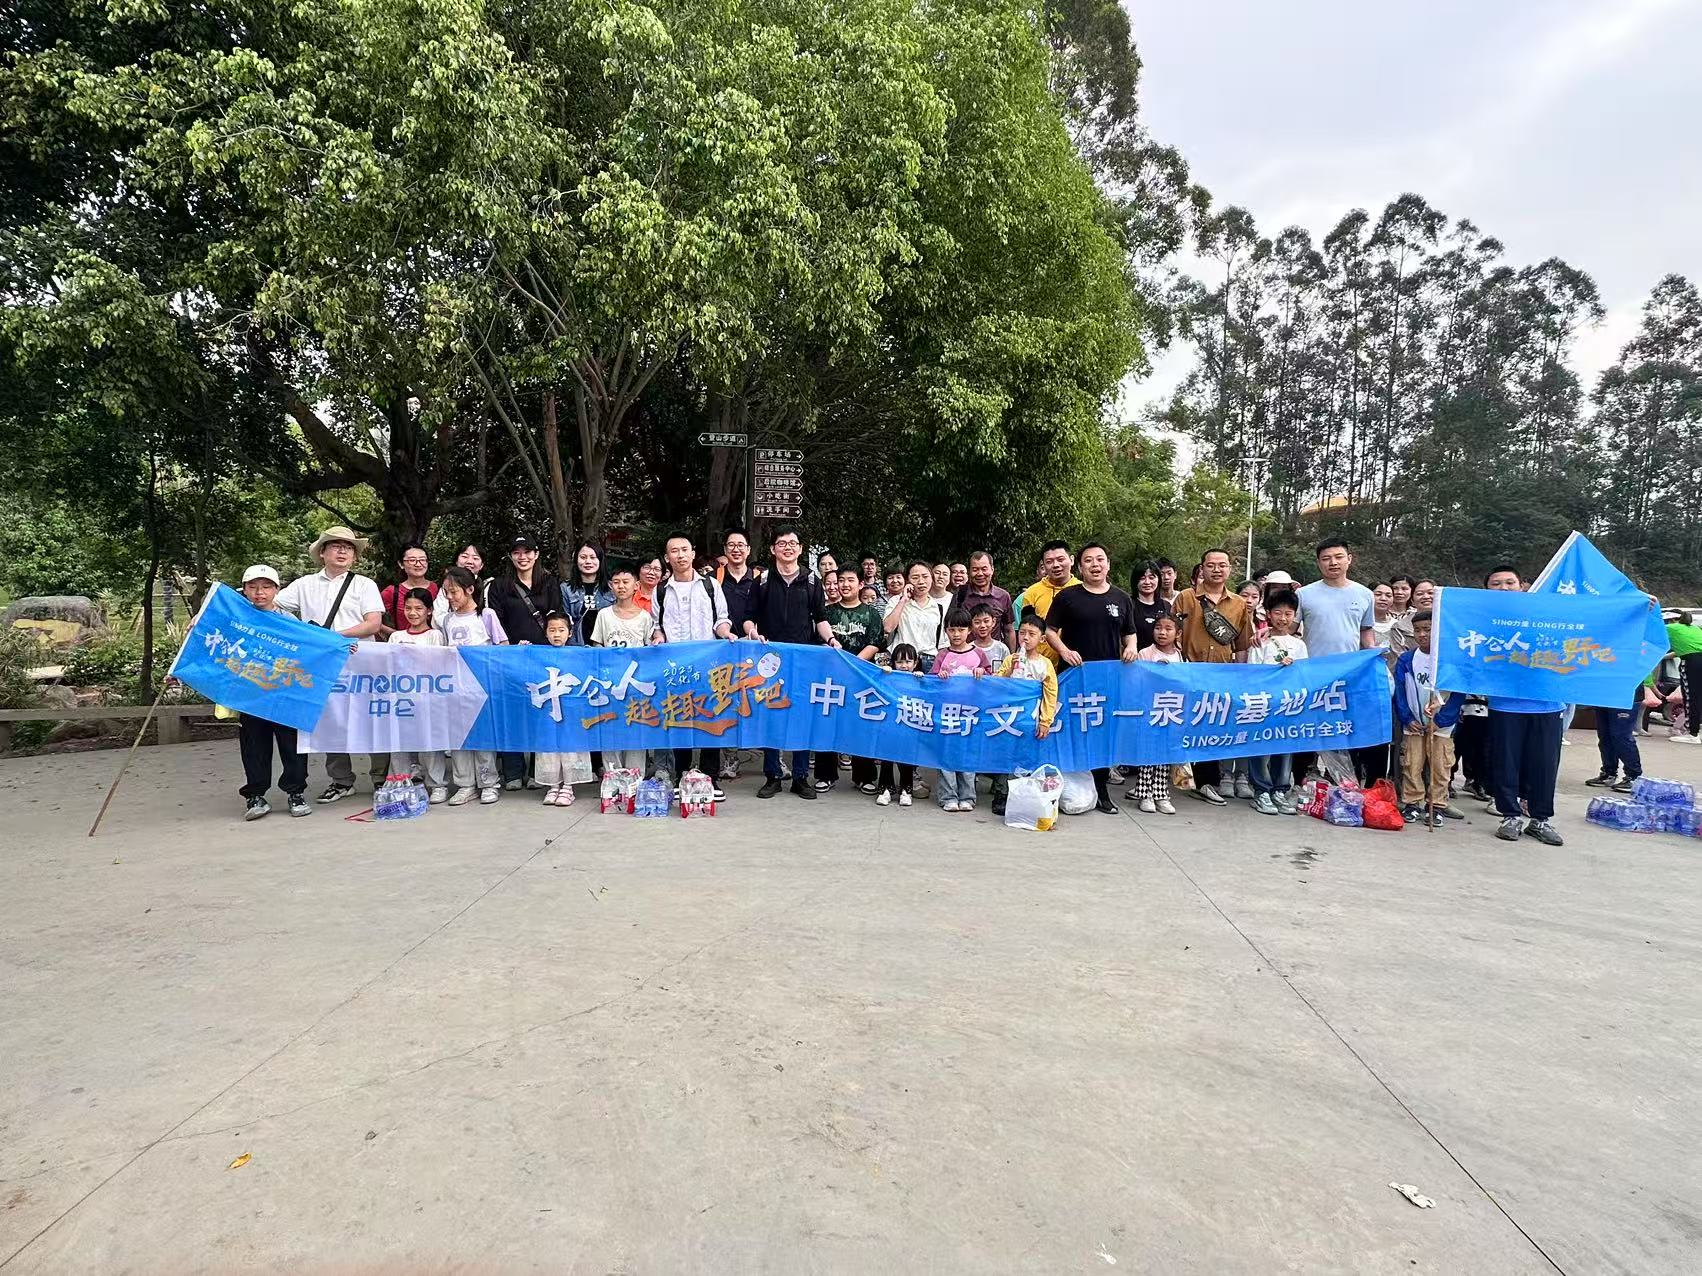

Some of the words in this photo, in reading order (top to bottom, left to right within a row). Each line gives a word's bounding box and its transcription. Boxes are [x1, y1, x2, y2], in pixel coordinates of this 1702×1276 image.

[663, 664, 694, 677] 2025
[526, 659, 657, 722] 中仑人
[368, 698, 416, 718] 中仑
[1253, 720, 1354, 742] LONG行全球
